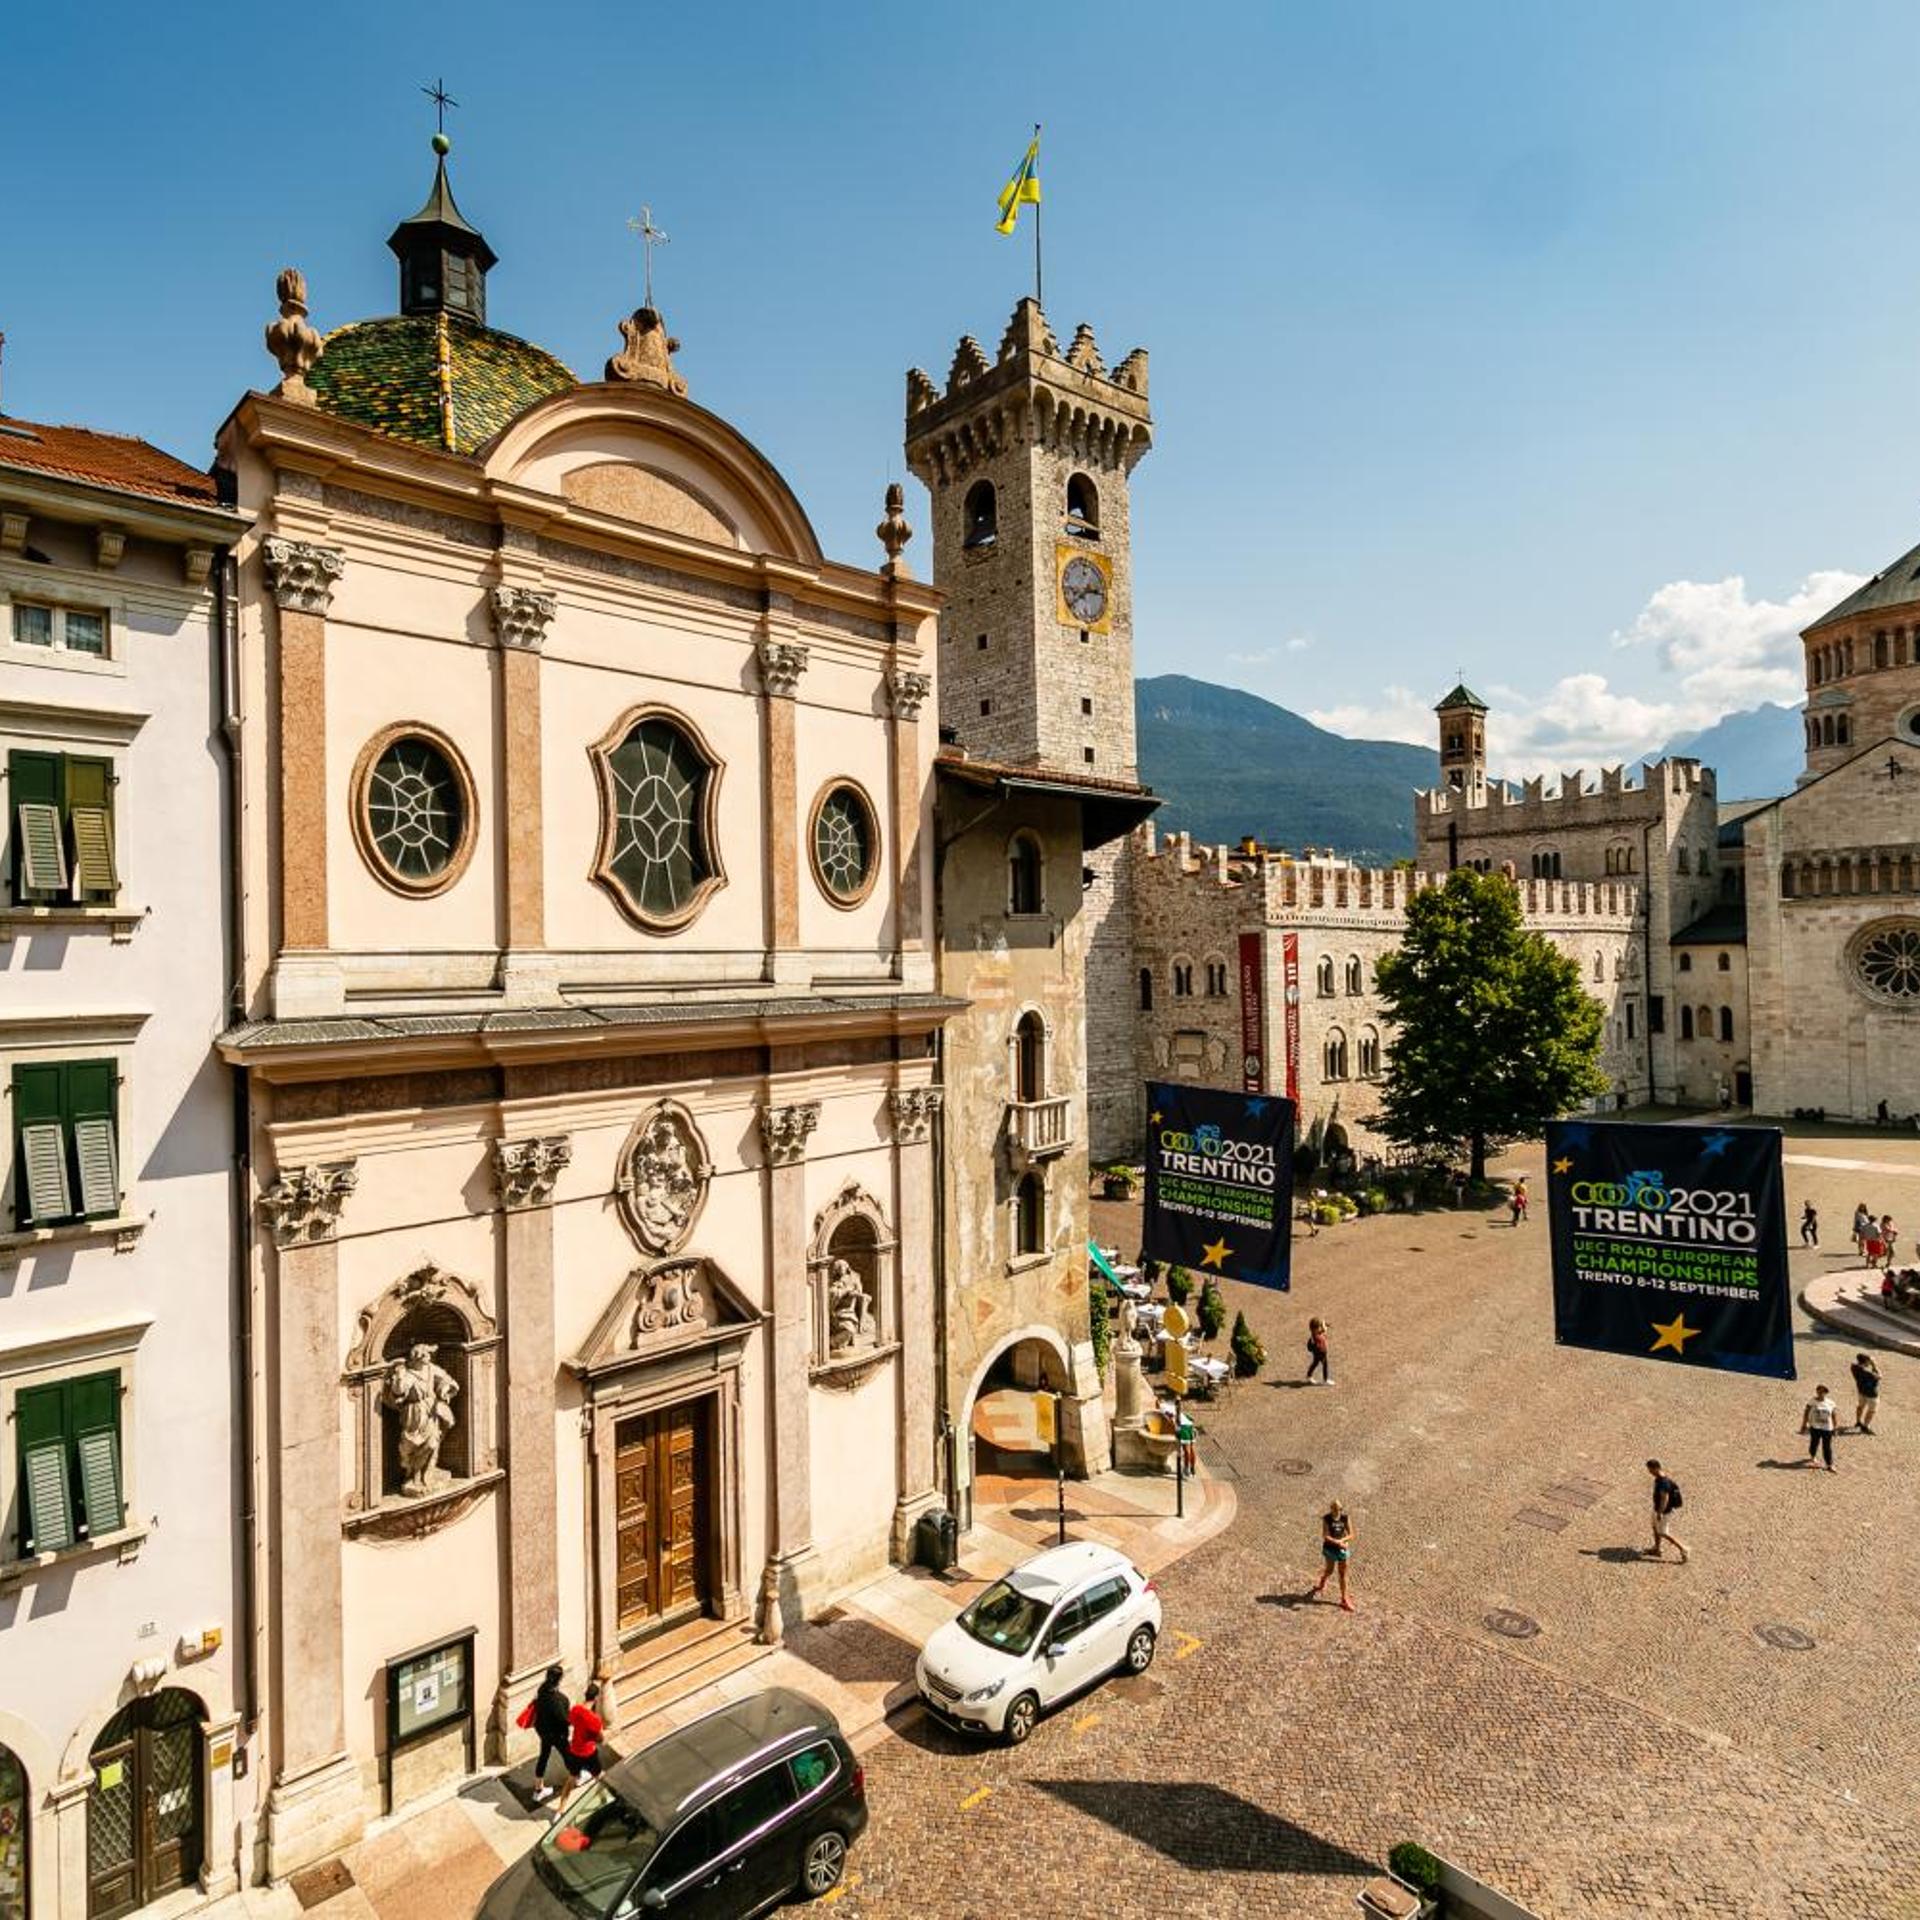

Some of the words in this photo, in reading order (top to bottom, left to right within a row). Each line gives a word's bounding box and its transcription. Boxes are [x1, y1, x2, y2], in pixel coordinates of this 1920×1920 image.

[1160, 1150, 1275, 1186] TRENTINO
[1222, 1140, 1276, 1167] 2021
[1159, 1187, 1273, 1220] CHAMPIONSHIPS
[1181, 1181, 1212, 1193] ROAD
[1215, 1185, 1274, 1205] EUROPEAN
[1669, 1188, 1756, 1219] 2021
[1159, 1199, 1195, 1215] TRENTO
[1217, 1211, 1273, 1230] SEPTEMBER
[1572, 1206, 1756, 1243] TRENTINO
[1574, 1240, 1606, 1253] UEC
[1610, 1243, 1658, 1258] ROAD
[1662, 1248, 1758, 1269] EUROPEAN
[1575, 1253, 1759, 1287] CHAMPIONSHIPS
[1576, 1269, 1633, 1286] TRENTO
[1637, 1276, 1666, 1290] 8-12
[1669, 1280, 1760, 1301] SEPTEMBER
